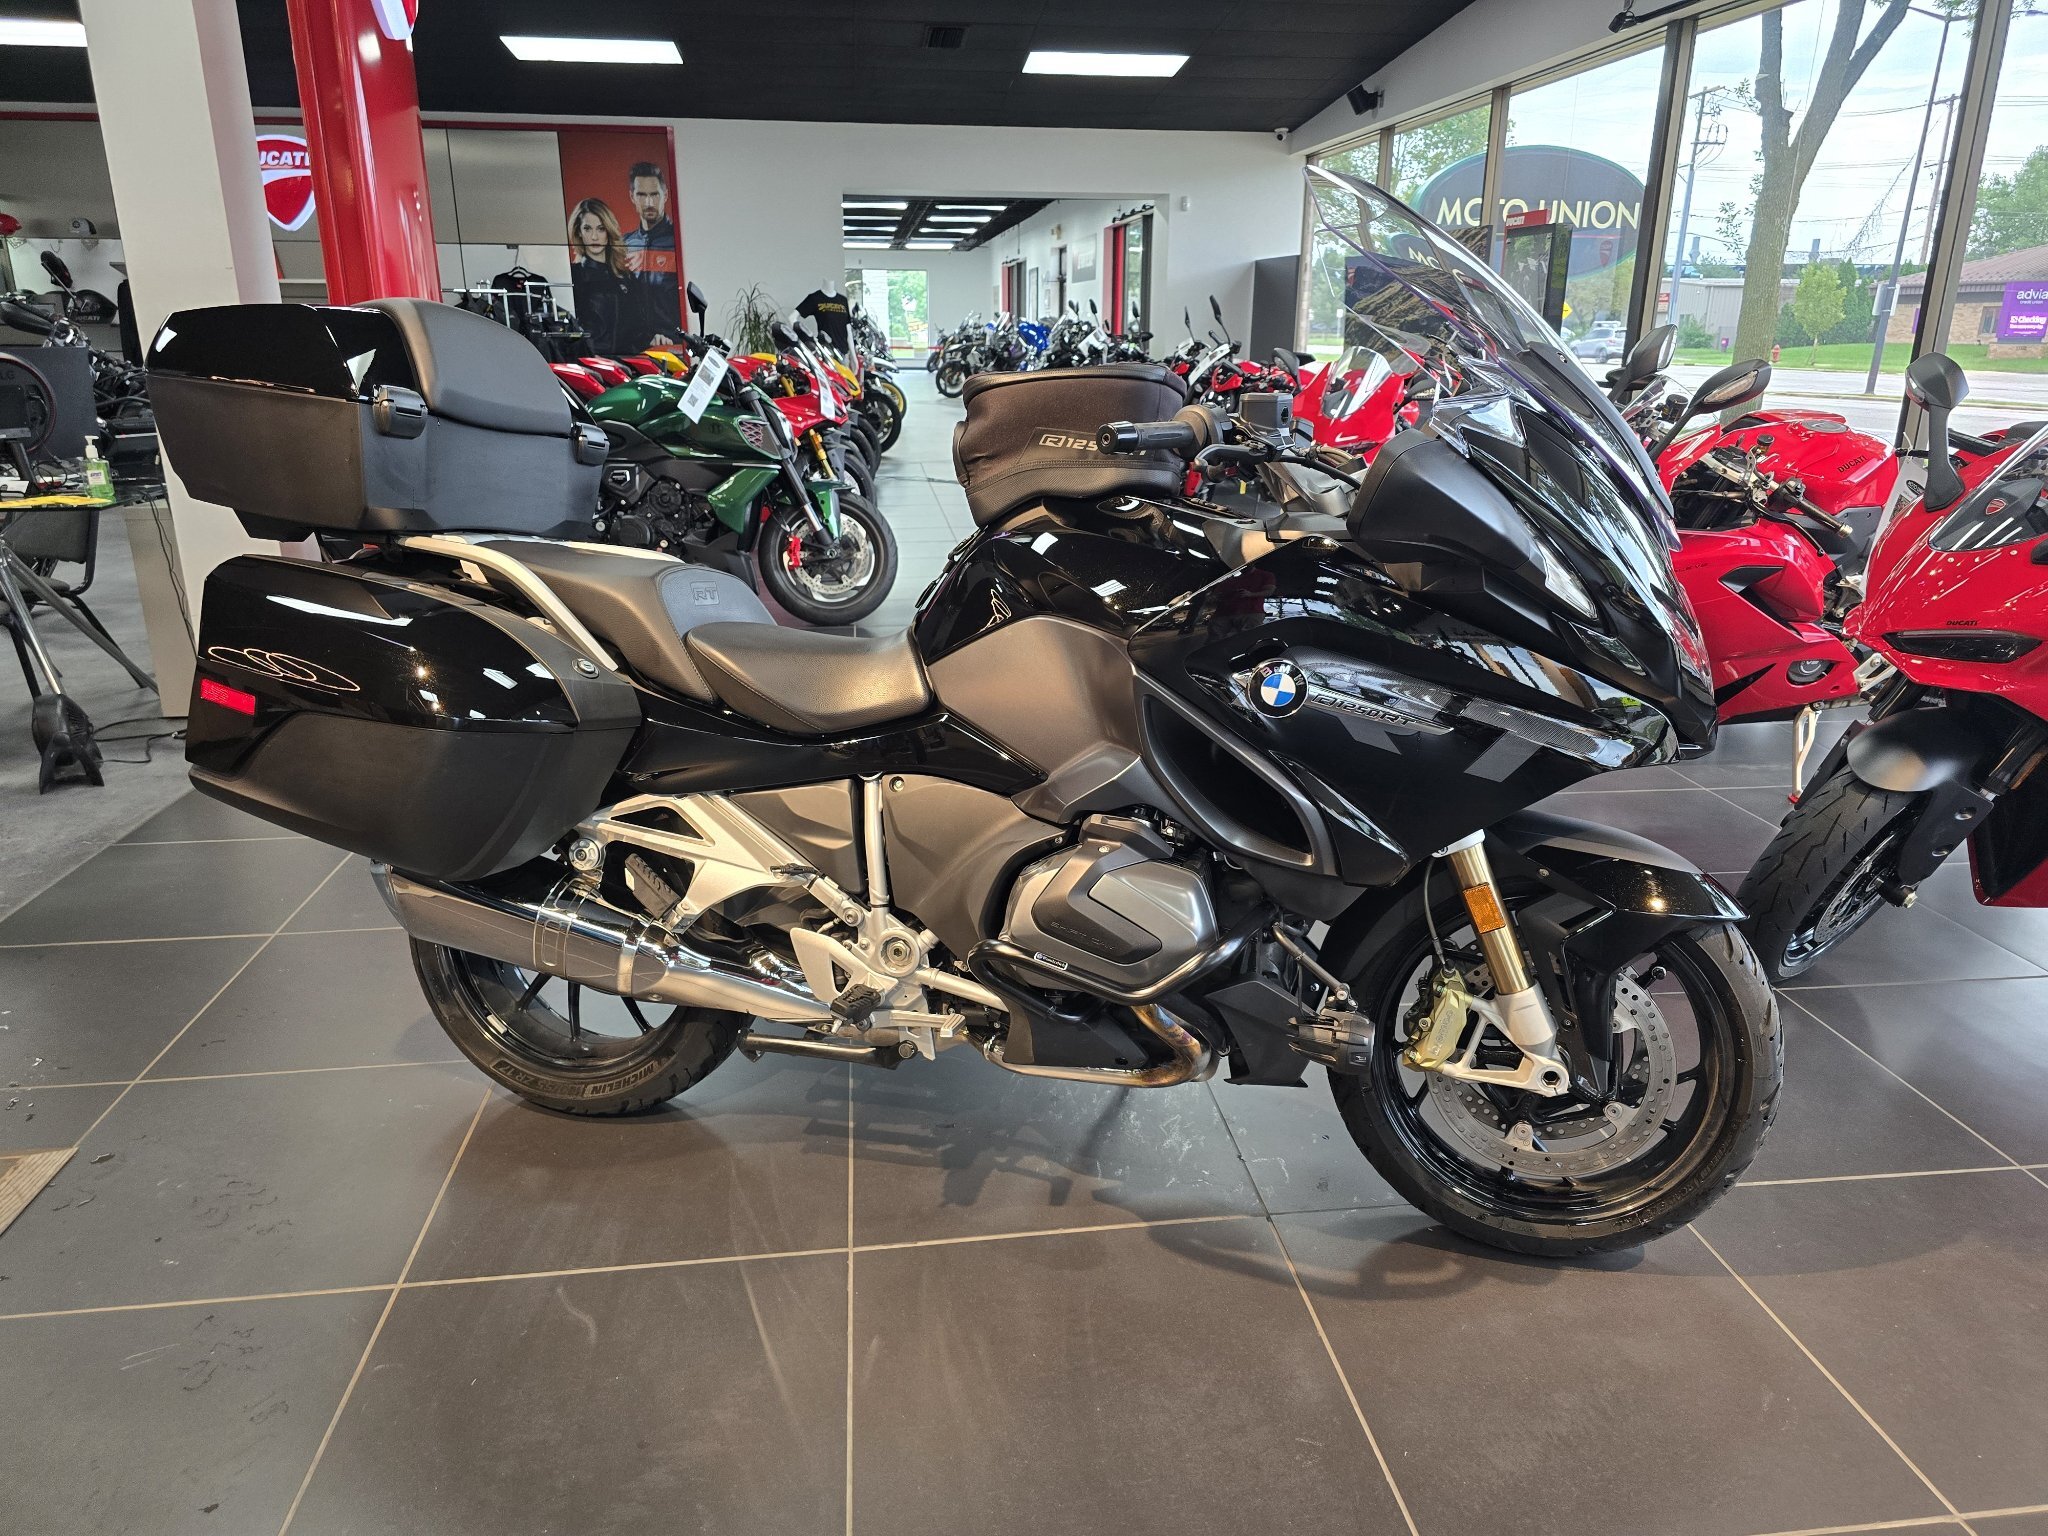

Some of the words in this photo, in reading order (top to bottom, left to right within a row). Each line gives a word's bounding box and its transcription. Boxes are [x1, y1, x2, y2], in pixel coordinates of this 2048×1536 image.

[1538, 199, 1641, 229] UNION
[2017, 289, 2048, 299] advia
[1837, 455, 1867, 473] DUCATI
[1260, 664, 1305, 686] BMW
[590, 1061, 655, 1096] MICHELIN
